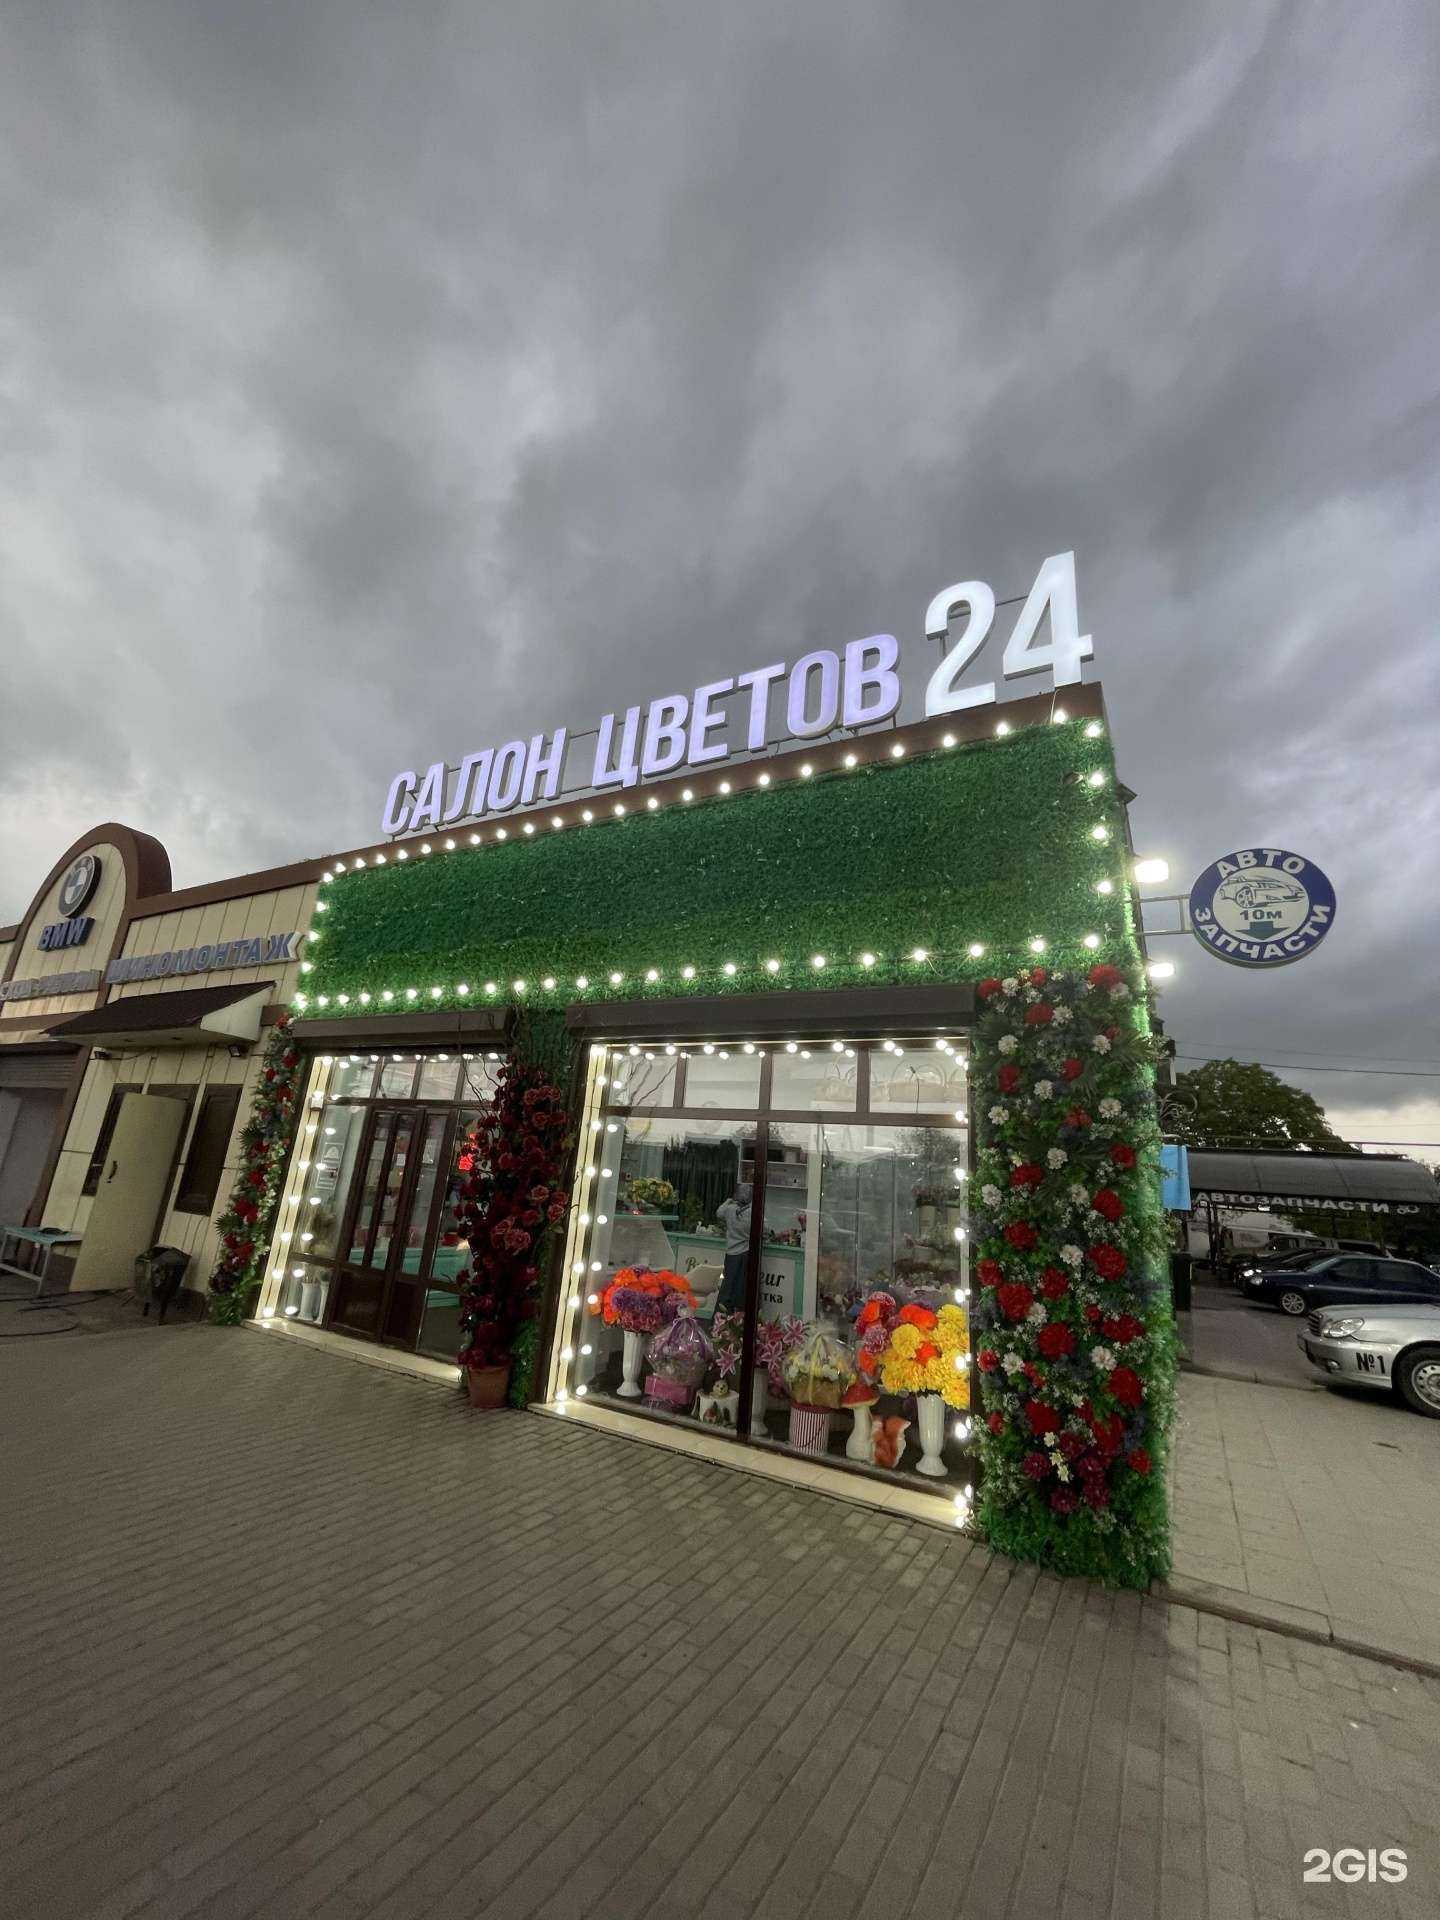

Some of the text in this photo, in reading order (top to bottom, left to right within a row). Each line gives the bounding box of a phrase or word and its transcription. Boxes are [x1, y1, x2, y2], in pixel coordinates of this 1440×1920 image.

[382, 550, 1094, 834] САЛОН ЦВЕТОВ 24
[1216, 849, 1305, 879] АВТО
[38, 917, 92, 950] BMW
[1194, 904, 1331, 960] ЗАПЧАСТИ
[1195, 1191, 1389, 1214] АВТОЗАПЧАСТИ
